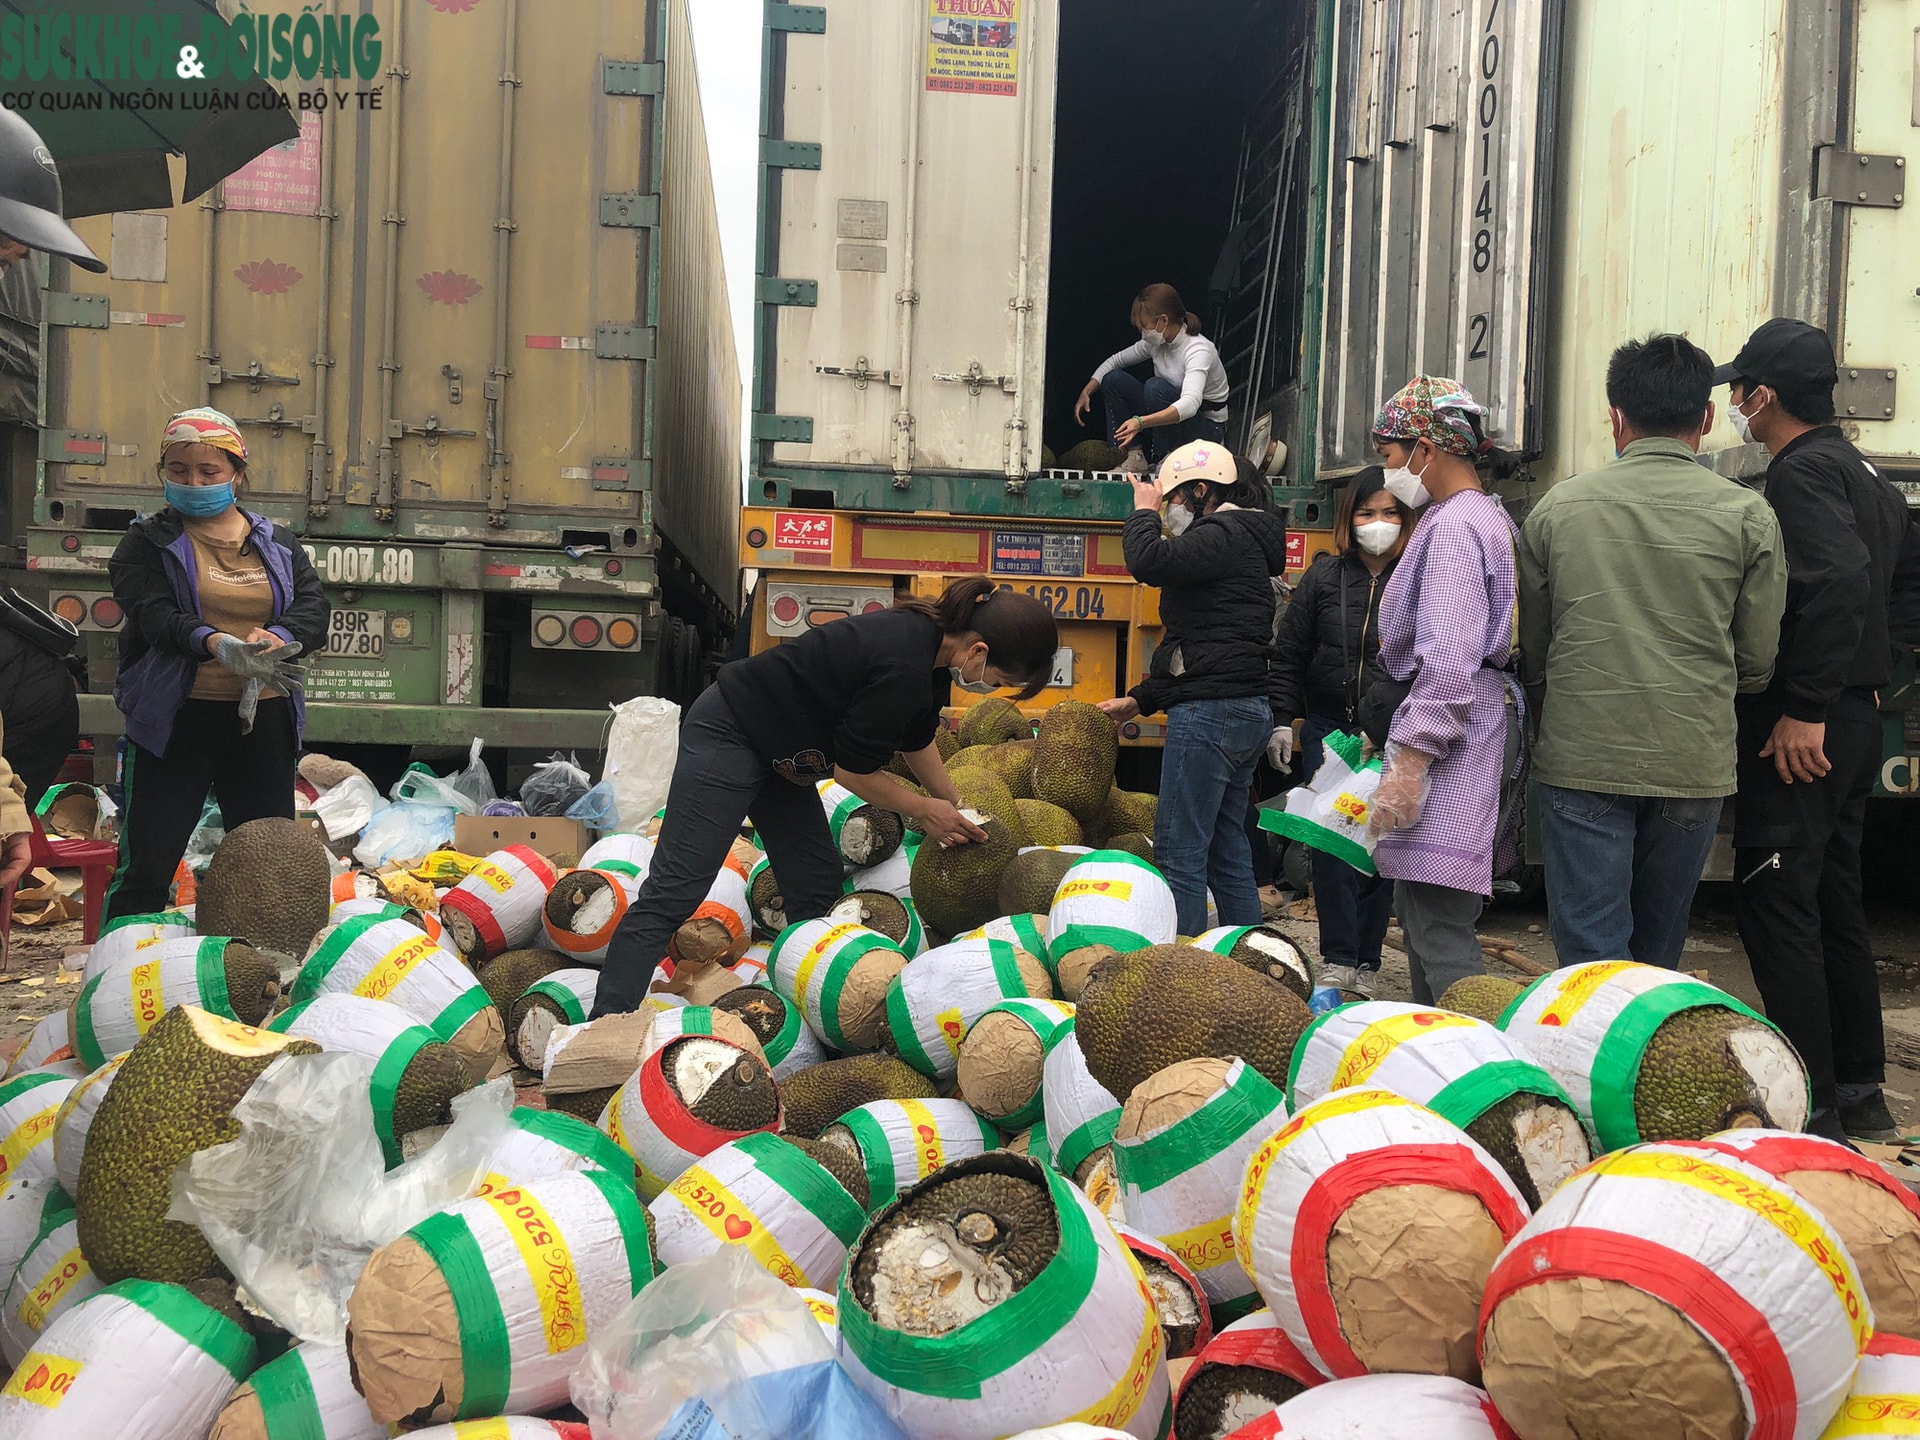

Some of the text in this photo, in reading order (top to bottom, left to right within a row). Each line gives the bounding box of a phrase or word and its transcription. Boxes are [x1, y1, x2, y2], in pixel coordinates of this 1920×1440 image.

[333, 611, 369, 632] 89R
[393, 944, 424, 970] 520
[139, 988, 156, 1022] 520
[690, 1185, 726, 1218] 520
[515, 1205, 554, 1247] 520
[37, 1262, 79, 1308] 520
[1807, 1237, 1860, 1322] 520
[1132, 1324, 1159, 1397] 520
